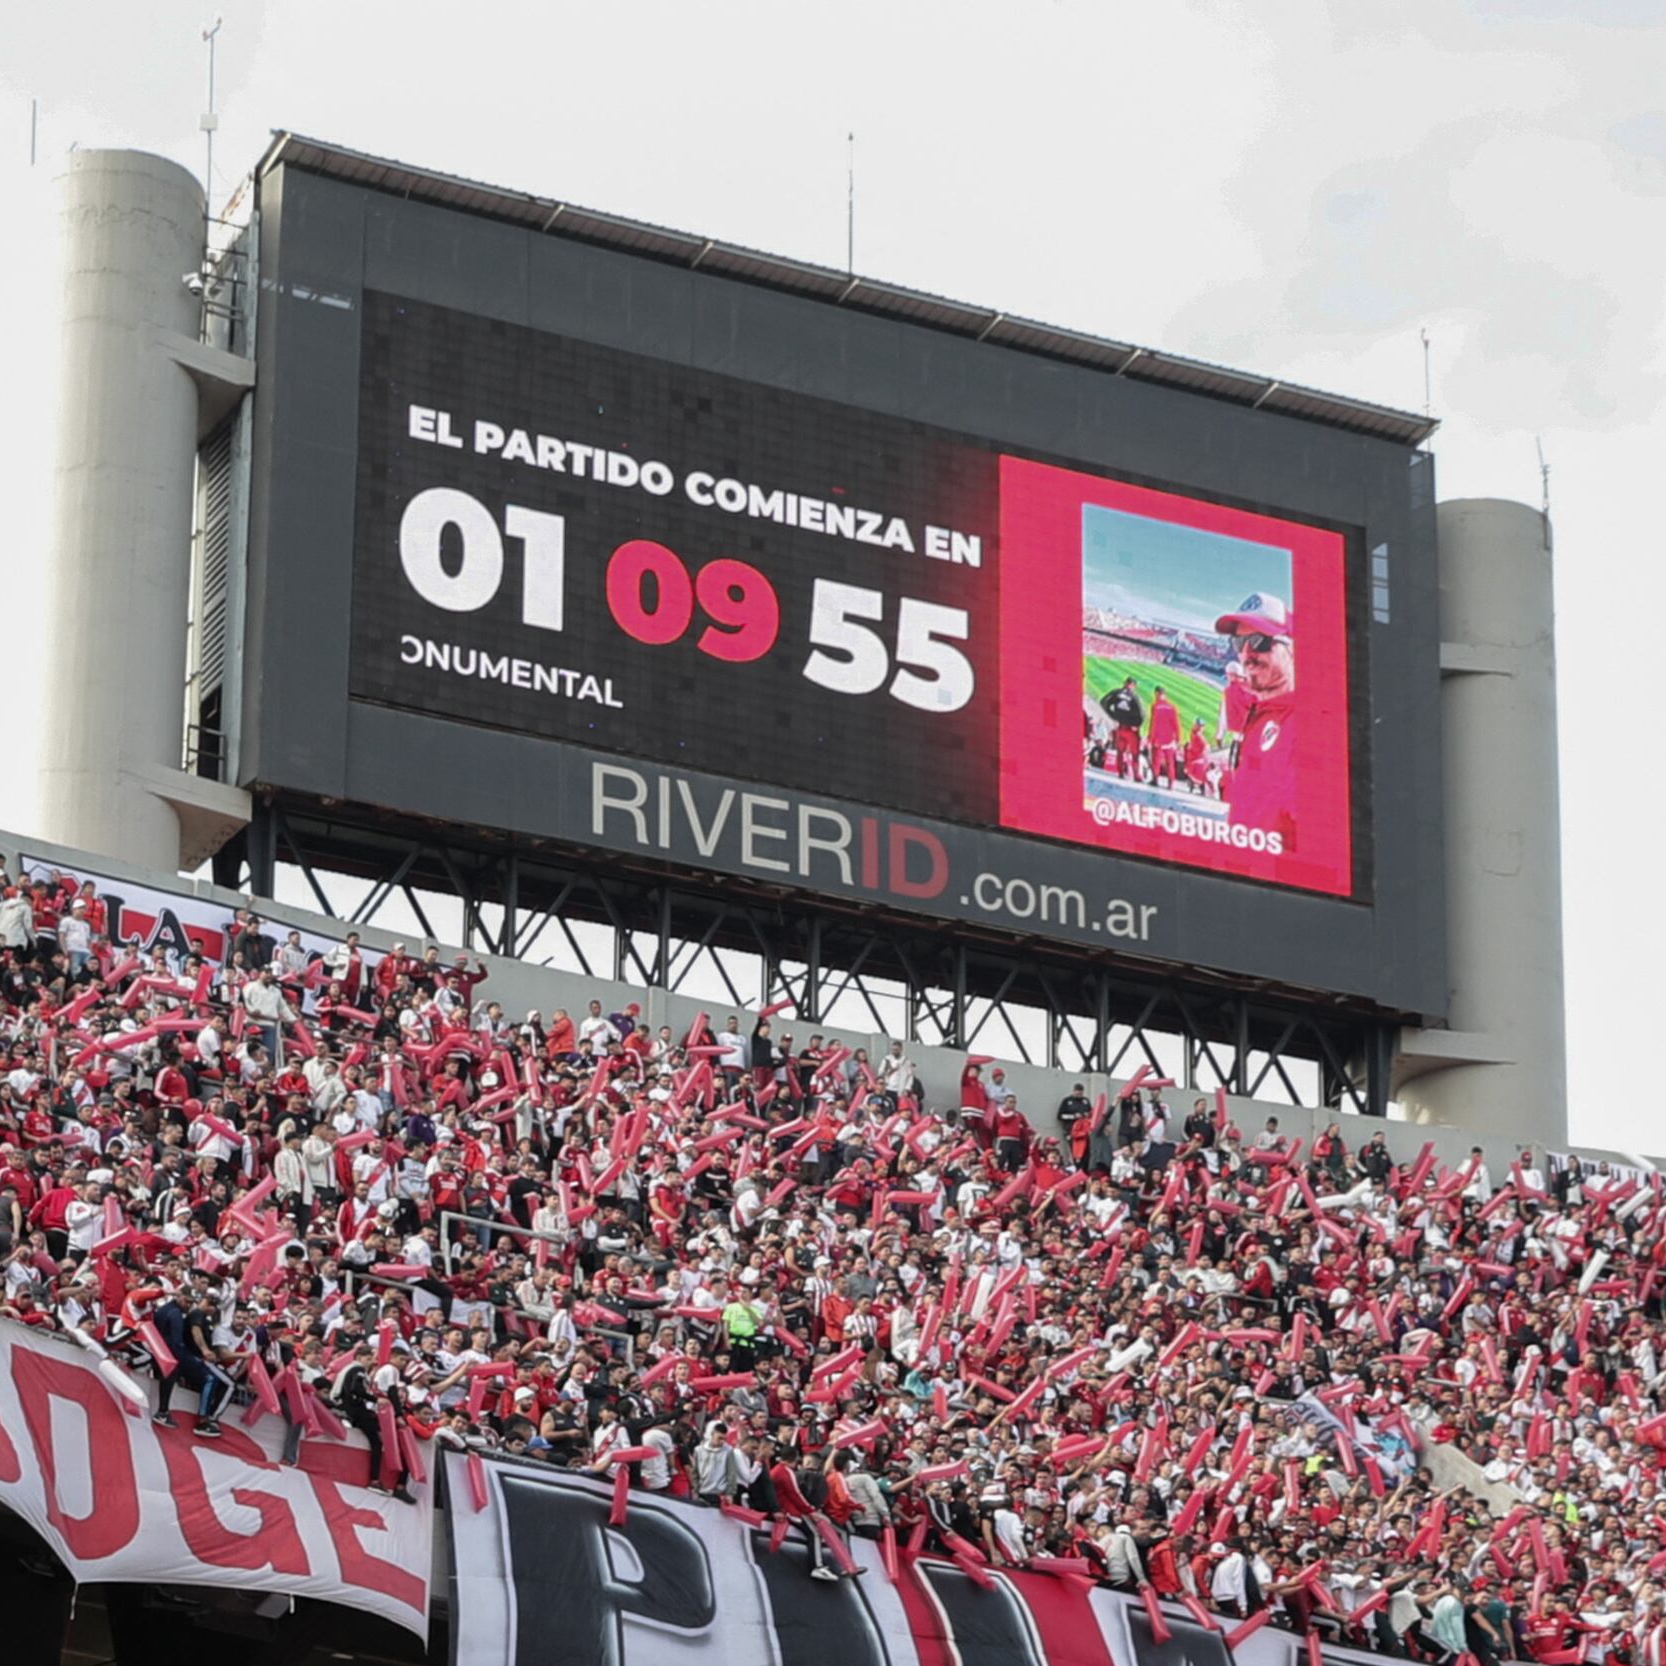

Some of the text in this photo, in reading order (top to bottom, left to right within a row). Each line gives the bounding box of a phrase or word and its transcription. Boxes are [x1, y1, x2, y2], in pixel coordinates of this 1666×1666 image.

[409, 403, 982, 568] EL PARTIDO COMIENZA EN
[399, 486, 975, 714] 01 09 55
[1091, 797, 1284, 856] @ALFOBURGOS
